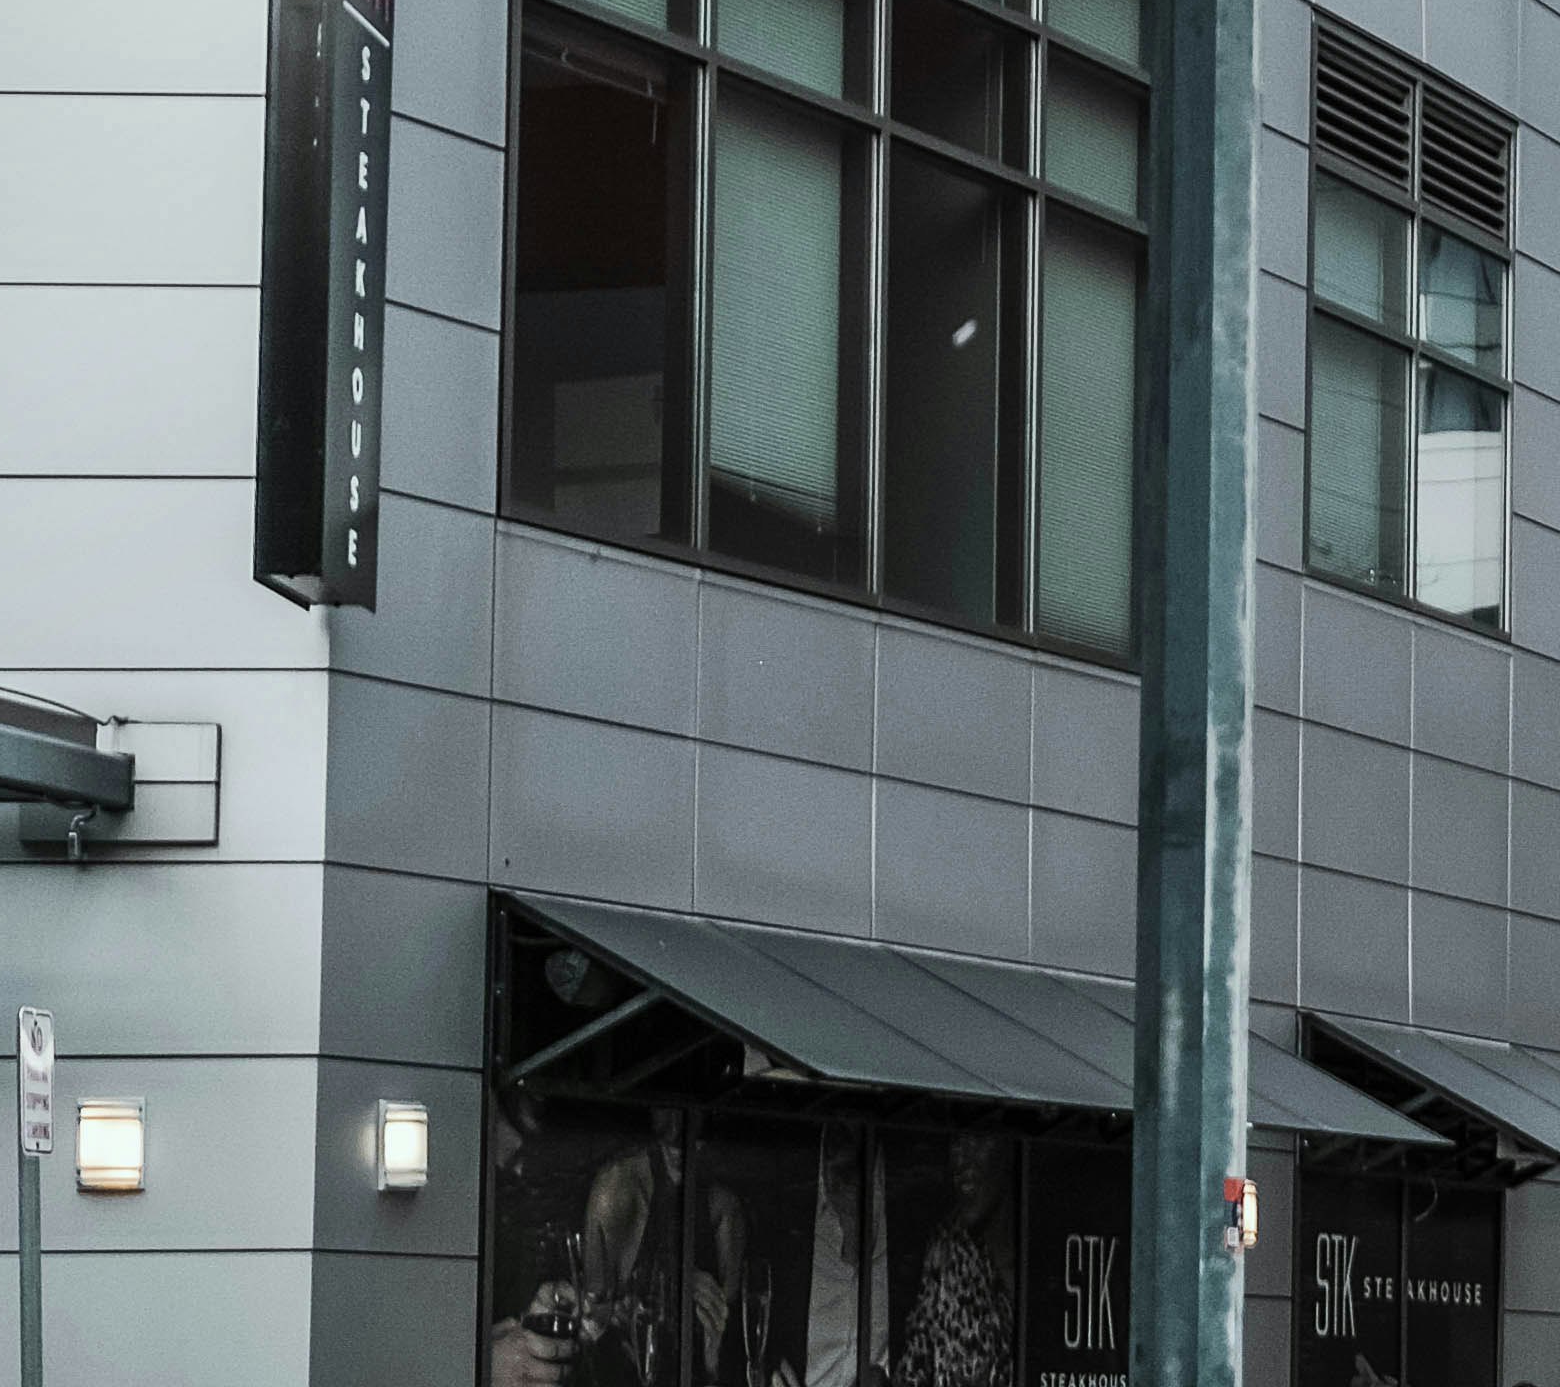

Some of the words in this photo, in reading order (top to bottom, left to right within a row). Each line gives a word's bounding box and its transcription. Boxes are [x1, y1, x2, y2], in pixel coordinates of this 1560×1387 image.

[348, 46, 371, 567] STEAKHOUSE
[1064, 1234, 1116, 1350] STK
[1315, 1233, 1357, 1337] STK
[1040, 1373, 1128, 1387] STEAKHOUS
